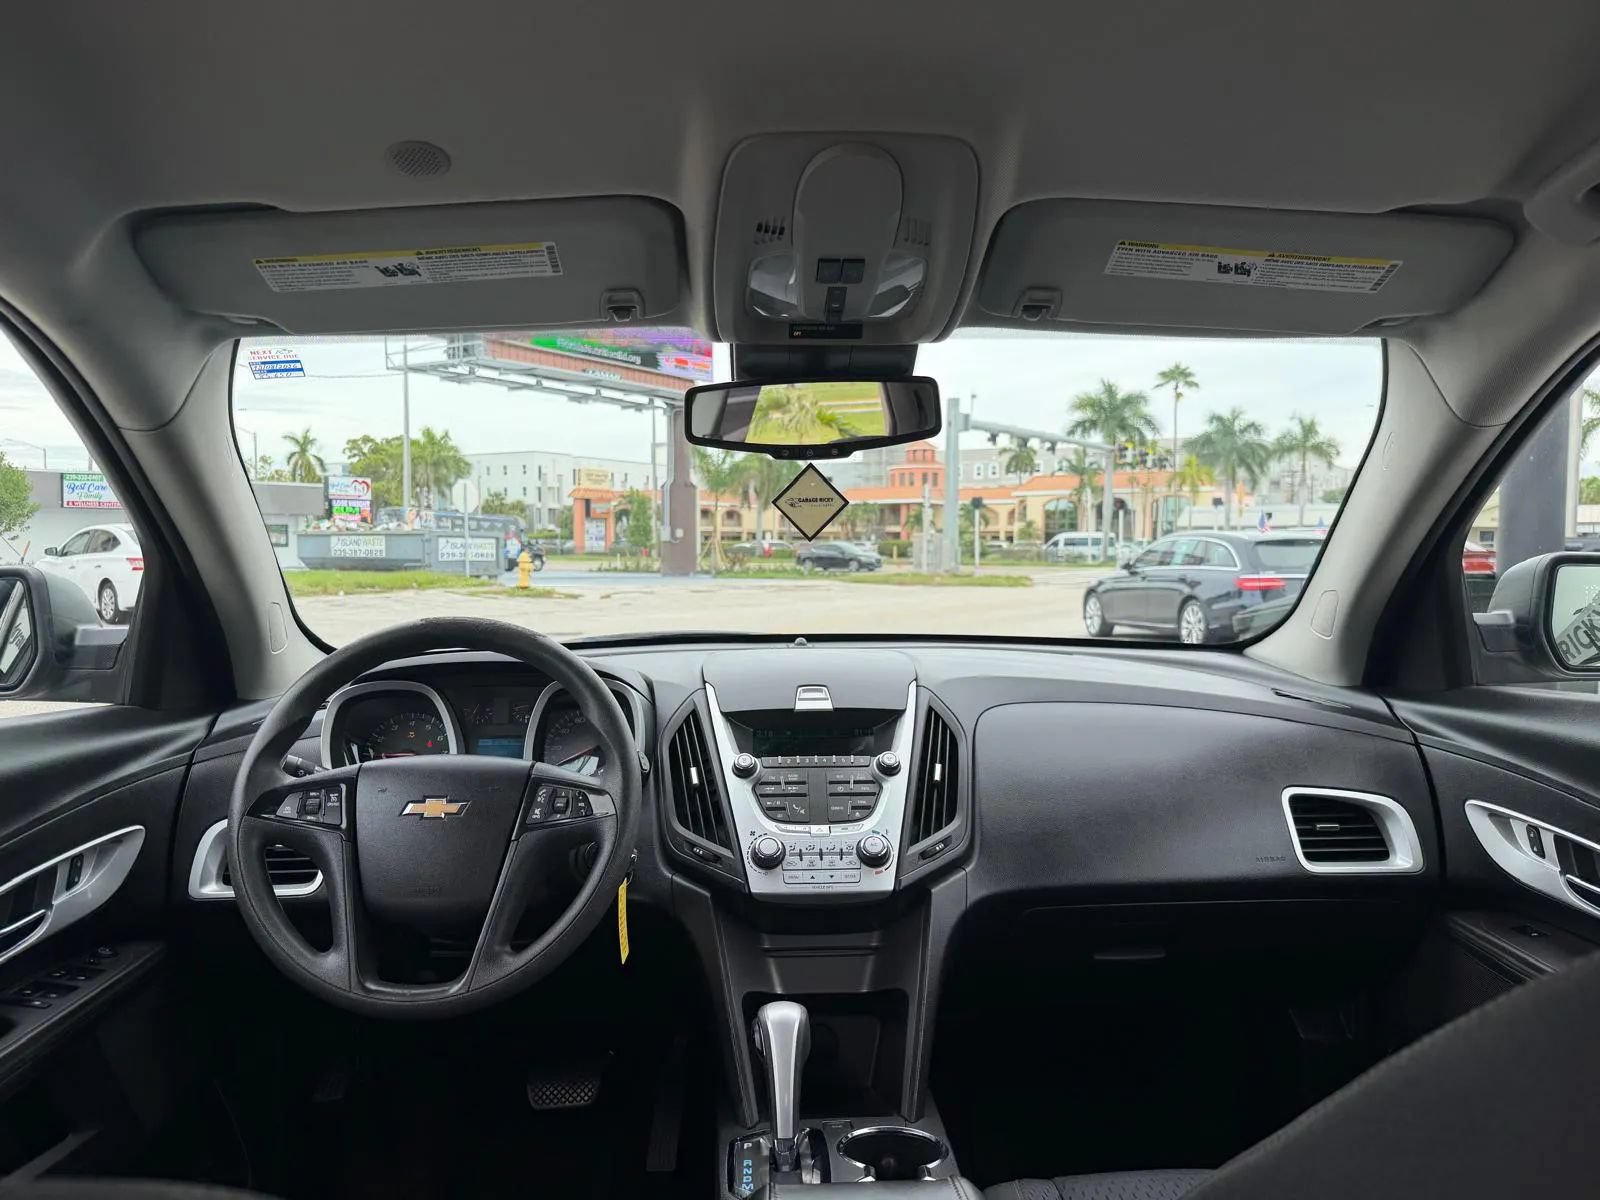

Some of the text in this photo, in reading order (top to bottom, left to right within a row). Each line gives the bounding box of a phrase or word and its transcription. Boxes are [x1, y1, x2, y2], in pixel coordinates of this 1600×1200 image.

[340, 537, 361, 547] ISLAND
[743, 1159, 752, 1167] R
[743, 1175, 752, 1183] D
